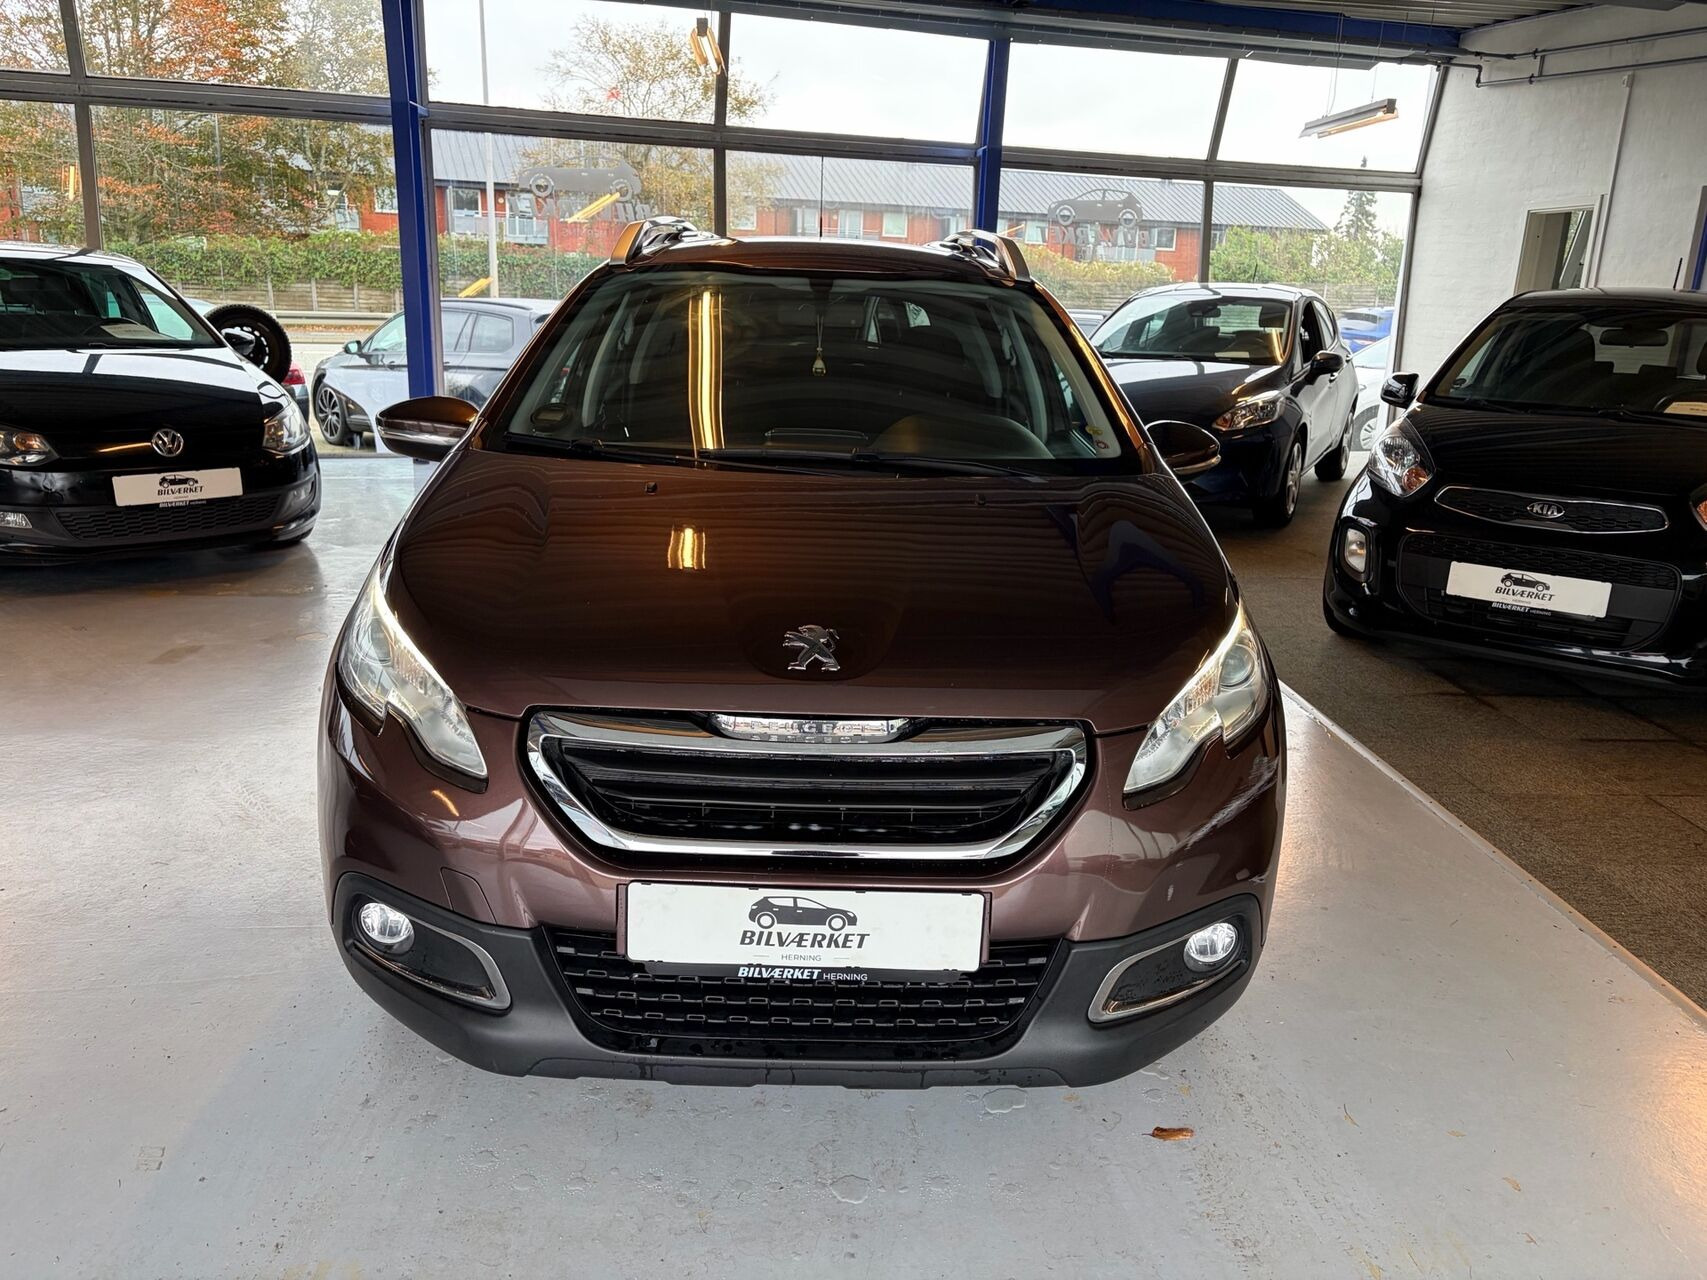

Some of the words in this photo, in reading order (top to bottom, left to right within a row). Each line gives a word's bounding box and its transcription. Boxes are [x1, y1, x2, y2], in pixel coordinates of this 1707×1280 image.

[158, 486, 203, 496] BILVÆRKET
[1532, 503, 1558, 515] KIA
[1496, 587, 1555, 601] BILVÆRKET
[739, 930, 870, 949] BILVÆRKET
[781, 954, 822, 962] HERNING
[737, 966, 821, 980] BILVÆRKET
[823, 972, 868, 981] HERNING
